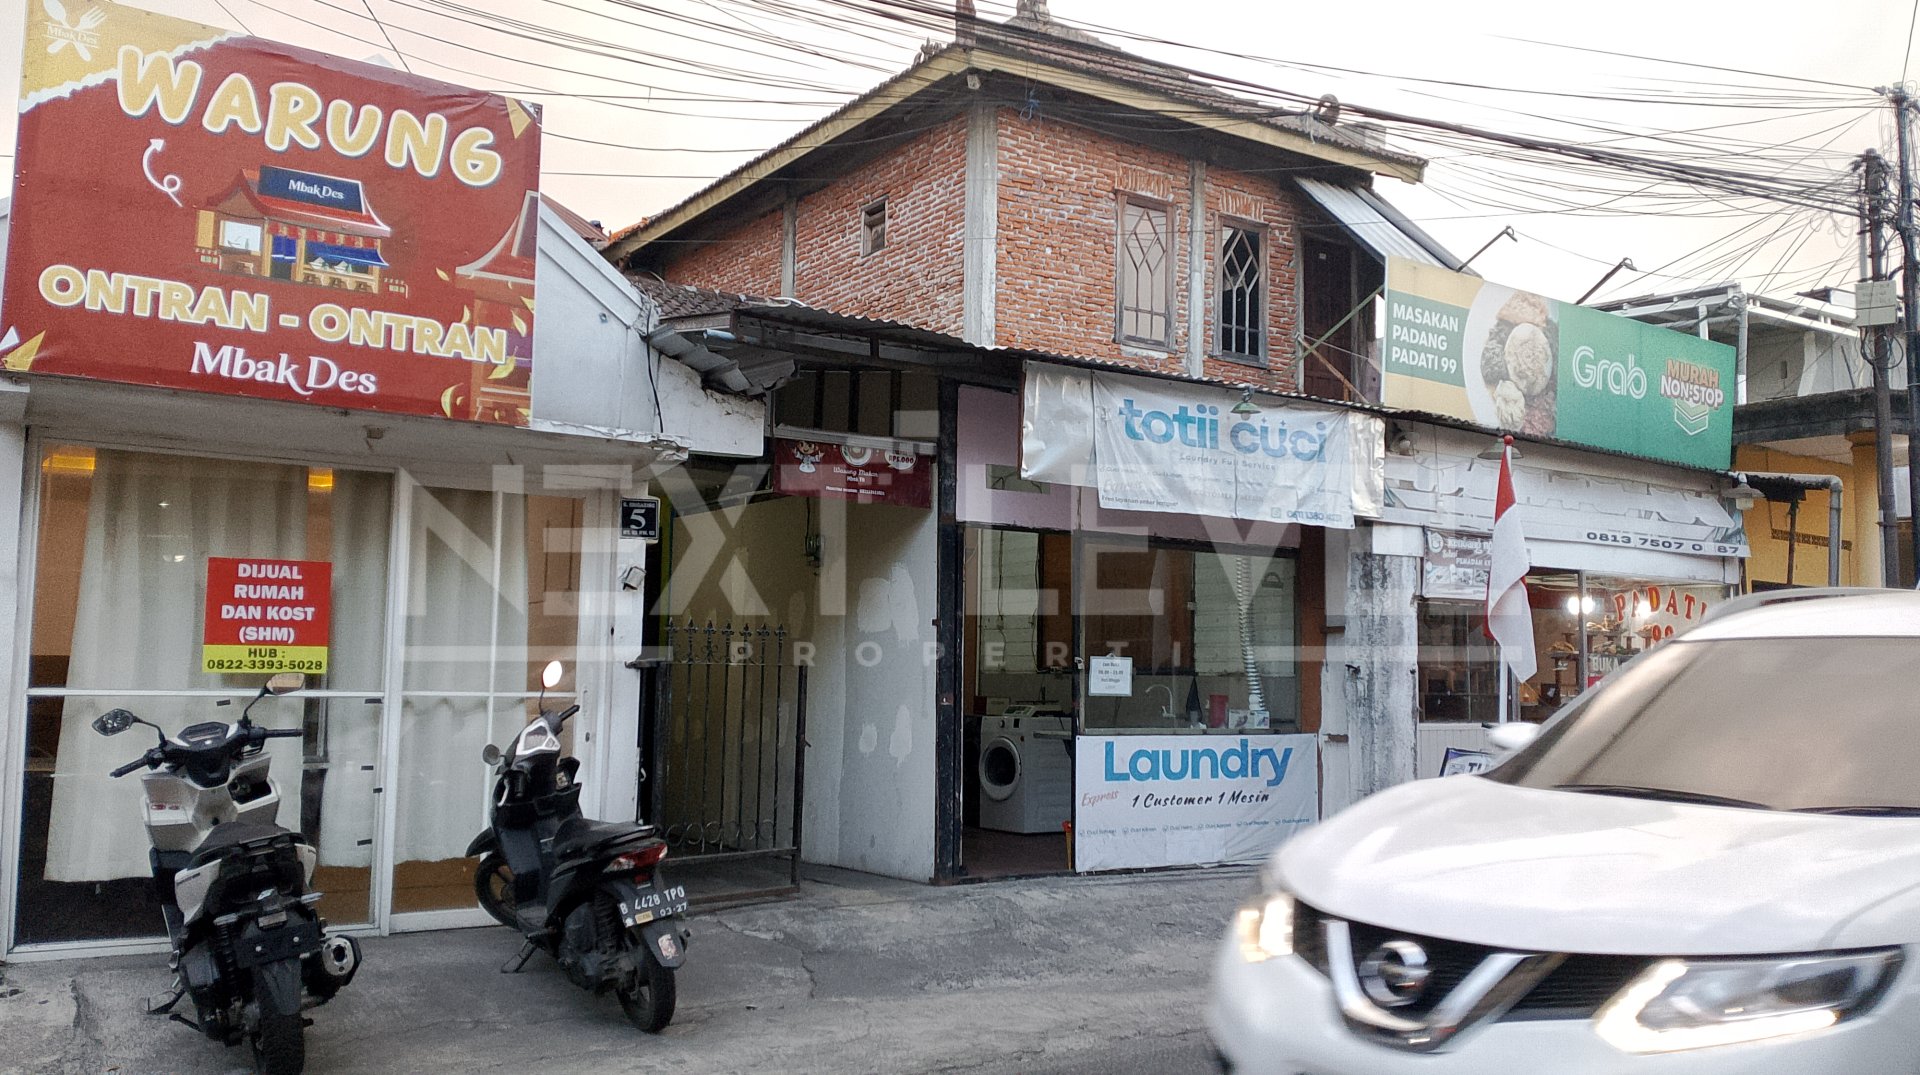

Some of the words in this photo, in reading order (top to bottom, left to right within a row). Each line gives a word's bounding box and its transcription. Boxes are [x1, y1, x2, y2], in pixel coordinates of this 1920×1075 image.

[116, 45, 502, 187] WARUNG
[288, 179, 324, 198] Mbak
[321, 186, 344, 200] Des
[38, 264, 269, 332] ONTRAN
[308, 303, 507, 365] ONTRAN
[1392, 302, 1459, 333] MASAKAN
[1392, 325, 1448, 351] PADANG
[189, 341, 314, 395] Mbak
[306, 355, 377, 394] Des
[1391, 346, 1438, 372] PADATI
[1441, 356, 1457, 374] 99
[1572, 345, 1647, 399] Grab
[1666, 358, 1720, 388] MURAH
[1118, 398, 1219, 450] totii
[1229, 417, 1327, 463] cuci
[630, 508, 646, 530] 5
[1586, 532, 1632, 544] 0813
[1638, 537, 1684, 550] 7507
[238, 563, 302, 580] DIJUAL
[234, 584, 304, 600] RUMAH
[221, 605, 261, 620] DAN
[266, 606, 315, 621] KOST
[239, 626, 295, 644] (SHM)
[248, 648, 277, 659] HUB
[207, 660, 322, 670] 0822-3393-5028
[1104, 738, 1293, 787] Laundry
[1081, 790, 1119, 807] Express
[1132, 795, 1140, 808] 1
[1143, 793, 1212, 808] Customer
[1218, 791, 1226, 805] 1
[1228, 789, 1270, 805] Mesin
[619, 902, 629, 915] B
